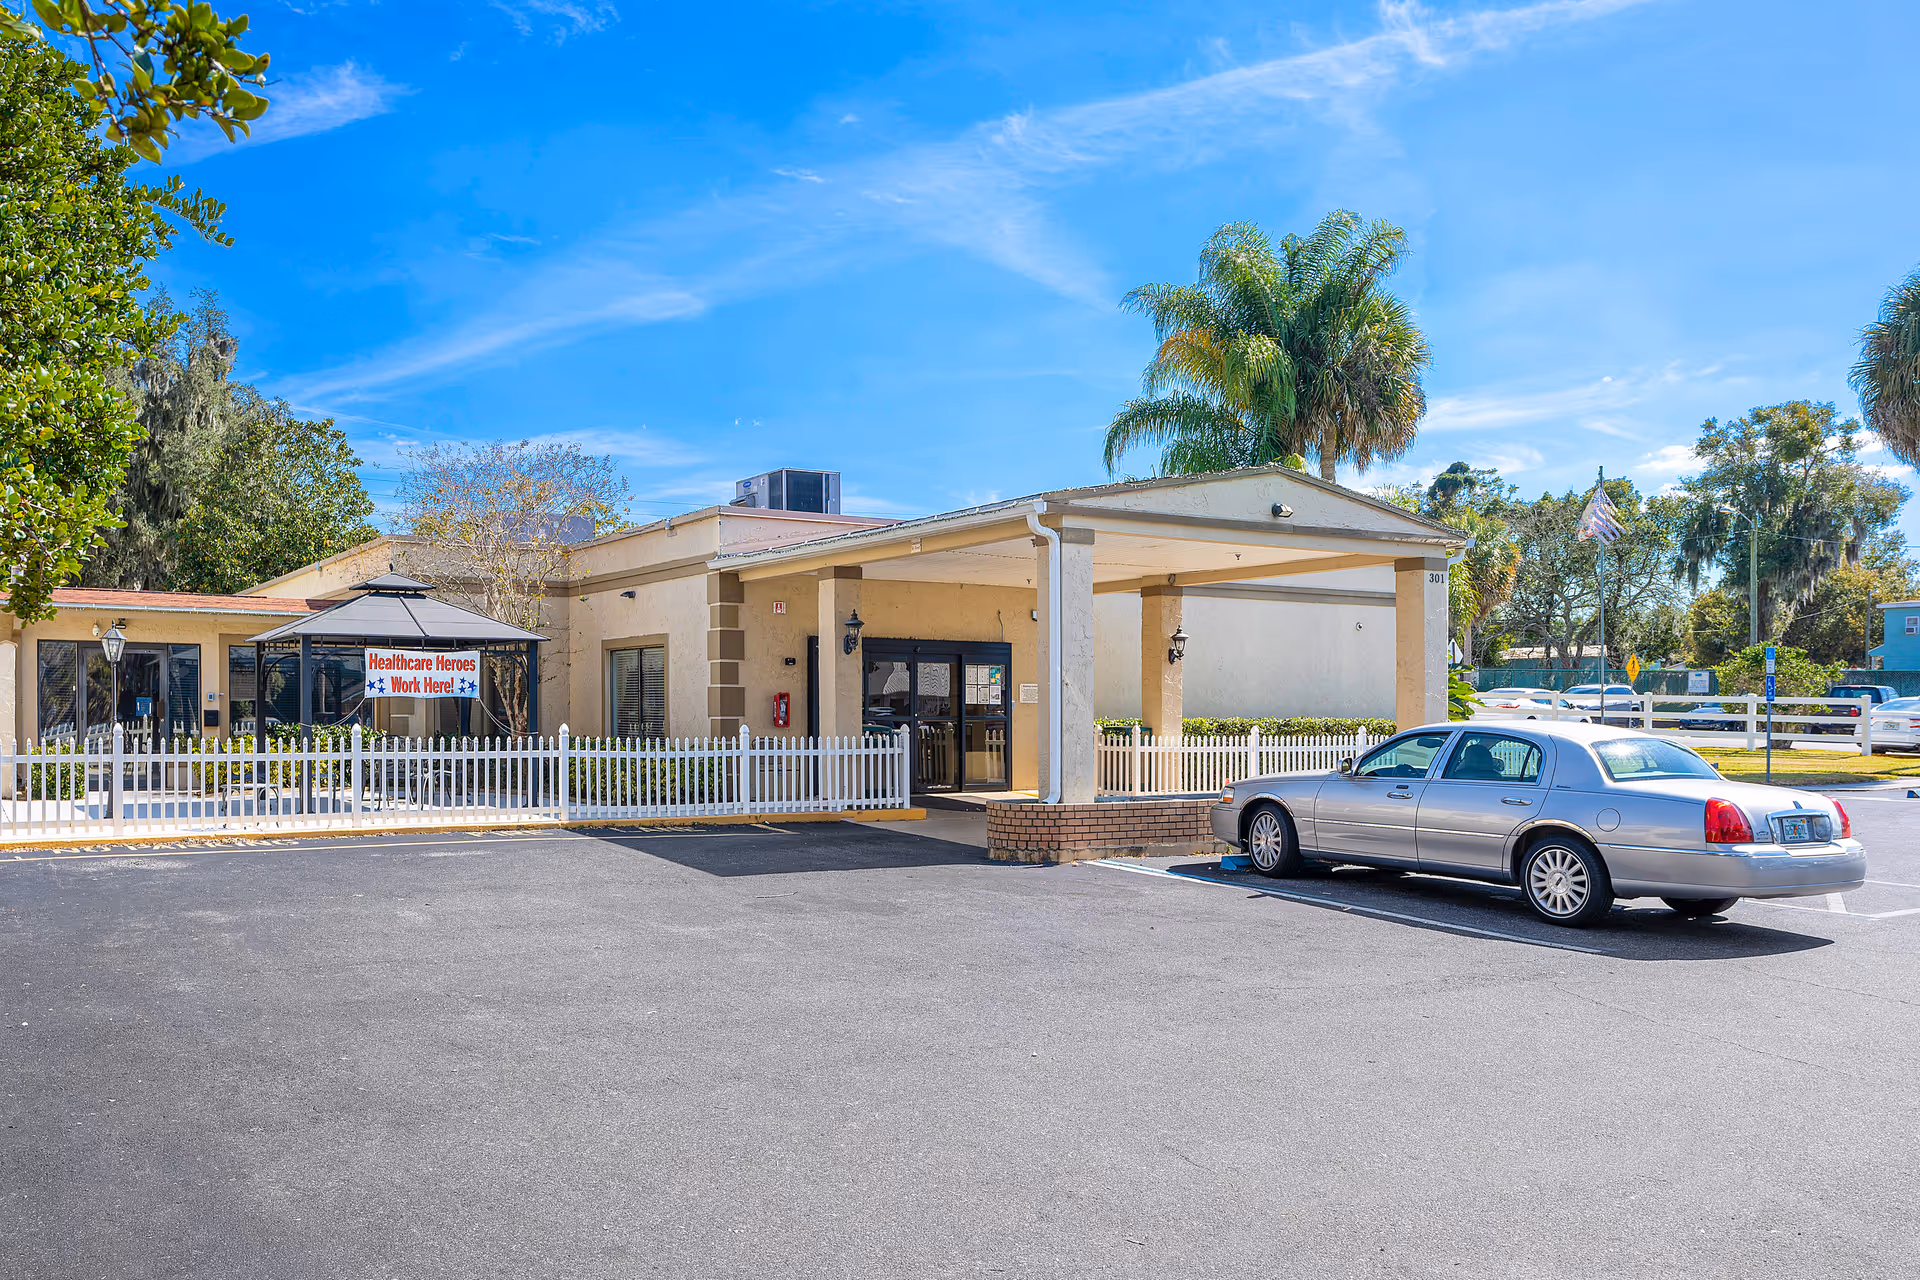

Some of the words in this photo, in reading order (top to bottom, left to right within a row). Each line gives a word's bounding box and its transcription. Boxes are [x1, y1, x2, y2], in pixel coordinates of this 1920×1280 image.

[1429, 573, 1444, 583] 301
[368, 652, 433, 671] Healthcare
[435, 655, 476, 671] Heroes
[390, 676, 421, 693] Work
[424, 677, 454, 693] Here!
